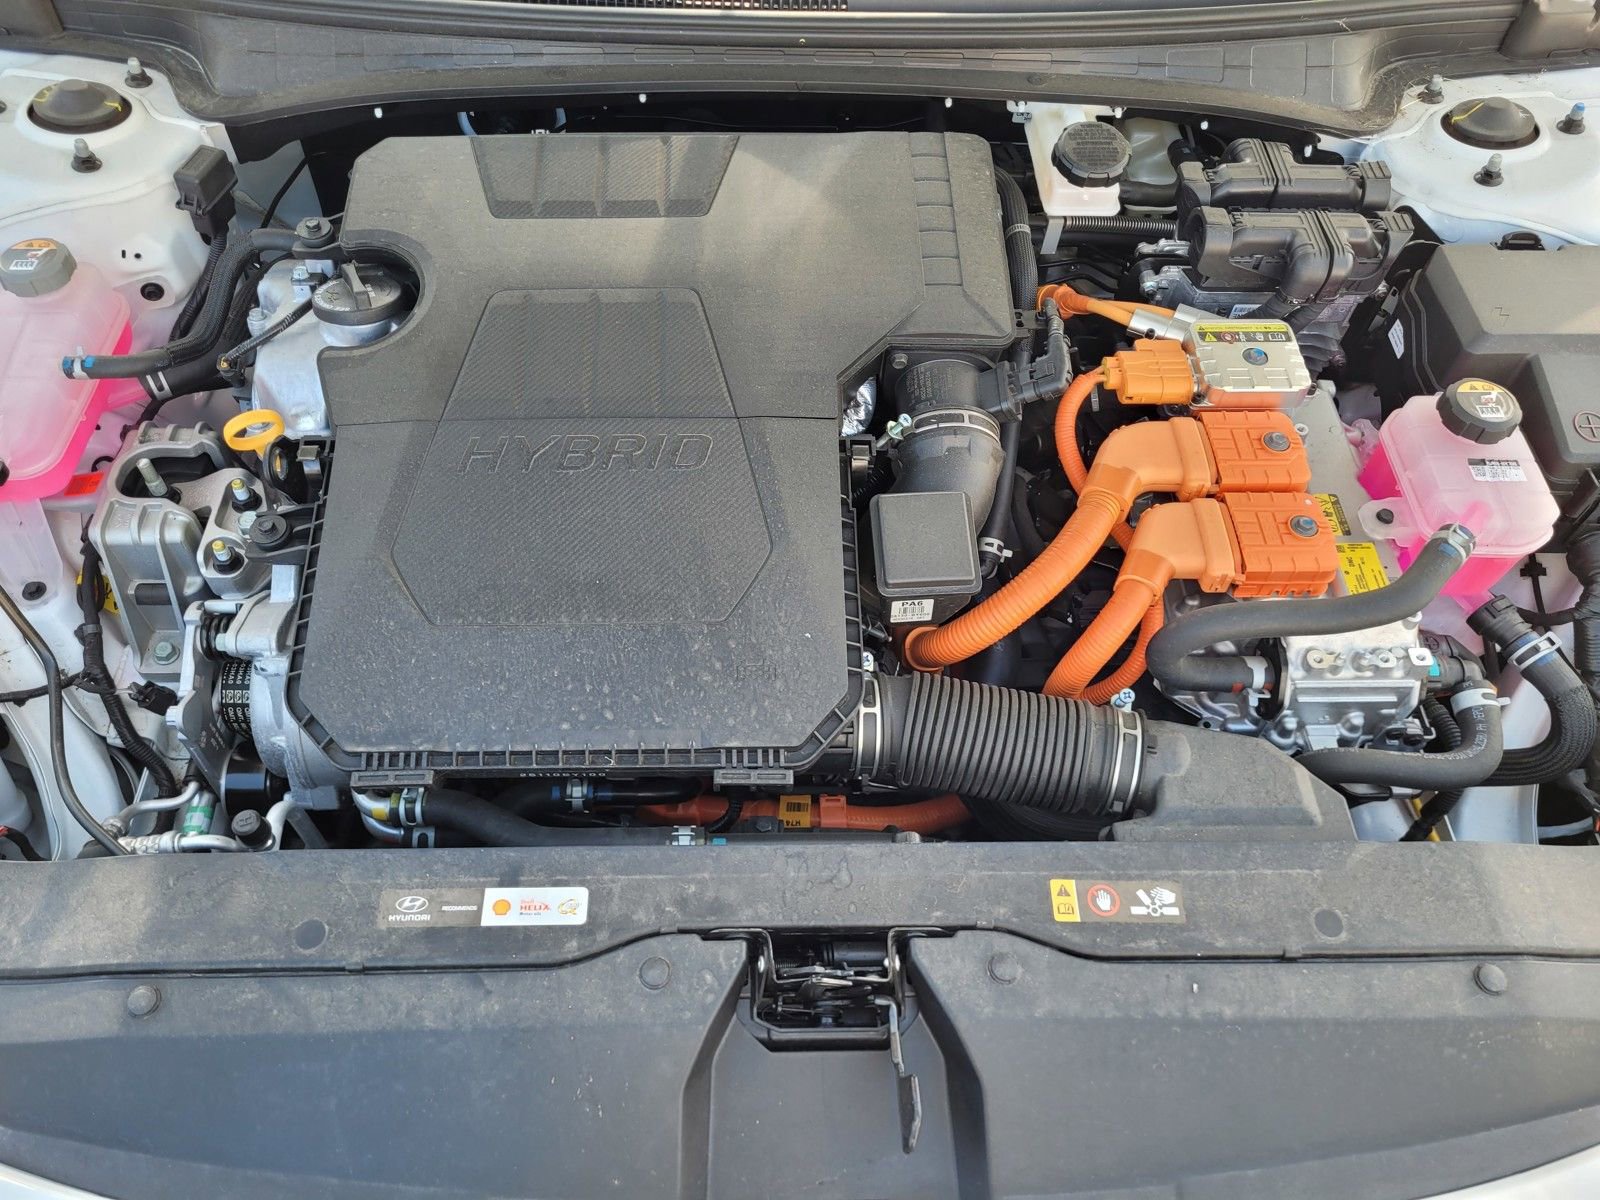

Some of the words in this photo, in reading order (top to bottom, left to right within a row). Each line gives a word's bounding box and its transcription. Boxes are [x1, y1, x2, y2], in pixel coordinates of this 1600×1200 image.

[457, 433, 714, 473] HYBRID
[520, 903, 550, 911] HELIX
[388, 914, 431, 922] HYUNDAI
